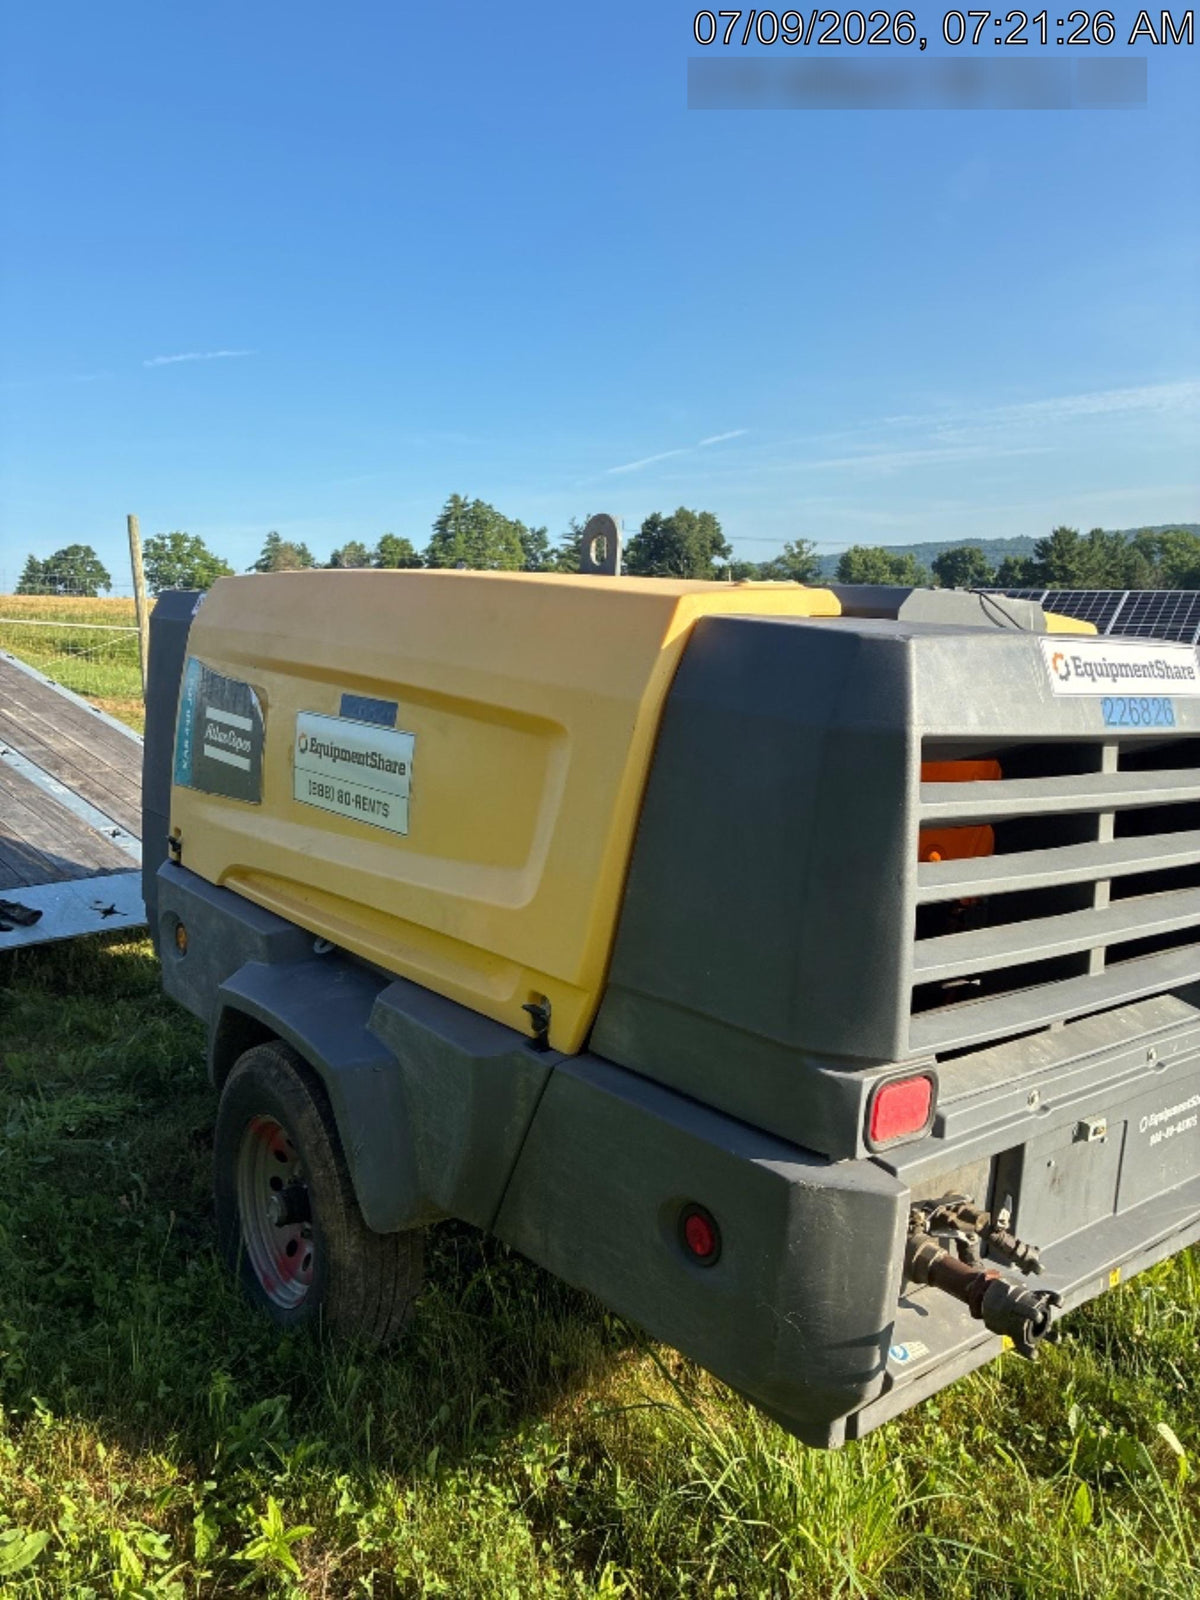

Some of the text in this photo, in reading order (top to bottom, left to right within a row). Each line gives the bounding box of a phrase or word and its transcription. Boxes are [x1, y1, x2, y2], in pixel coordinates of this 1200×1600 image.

[1070, 655, 1196, 683] EquipmentShare
[1103, 697, 1174, 726] 226826
[309, 737, 406, 776] EquipmentShare
